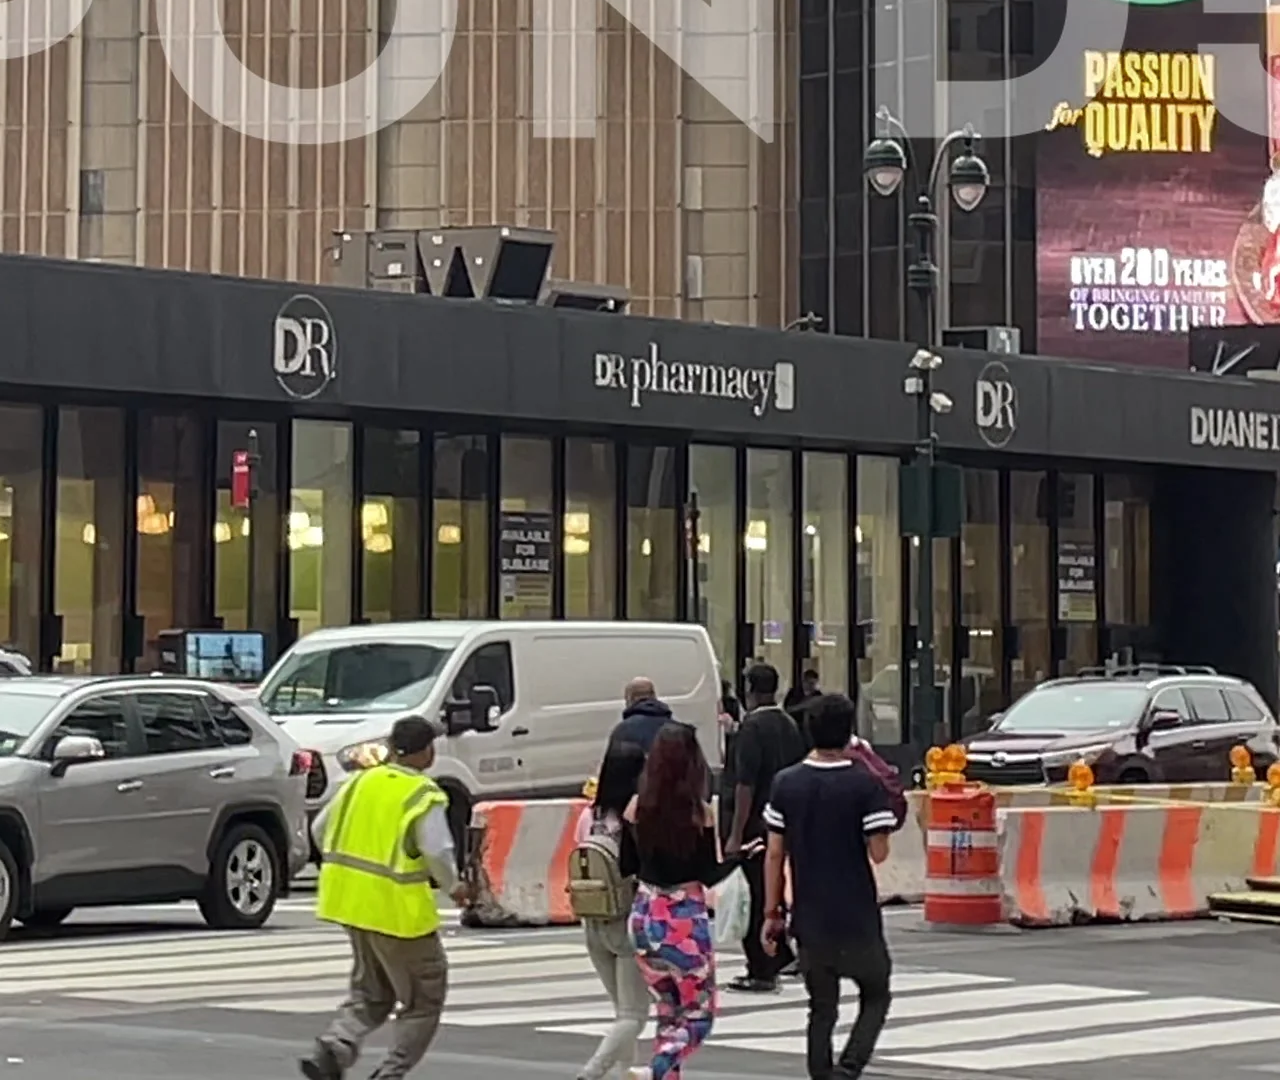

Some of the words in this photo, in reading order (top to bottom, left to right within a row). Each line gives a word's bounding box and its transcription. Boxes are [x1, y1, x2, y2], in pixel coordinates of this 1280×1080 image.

[1085, 50, 1215, 100] PASSION
[1045, 101, 1083, 131] for
[1085, 101, 1216, 158] QUALITY
[1070, 257, 1117, 286] OVER
[1121, 248, 1169, 287] 200
[1172, 259, 1231, 287] YEARS
[1070, 302, 1227, 332] TOGETHER
[274, 316, 330, 377] DR
[595, 353, 628, 388] DR
[631, 341, 774, 417] pharmacy
[976, 379, 1014, 429] DR
